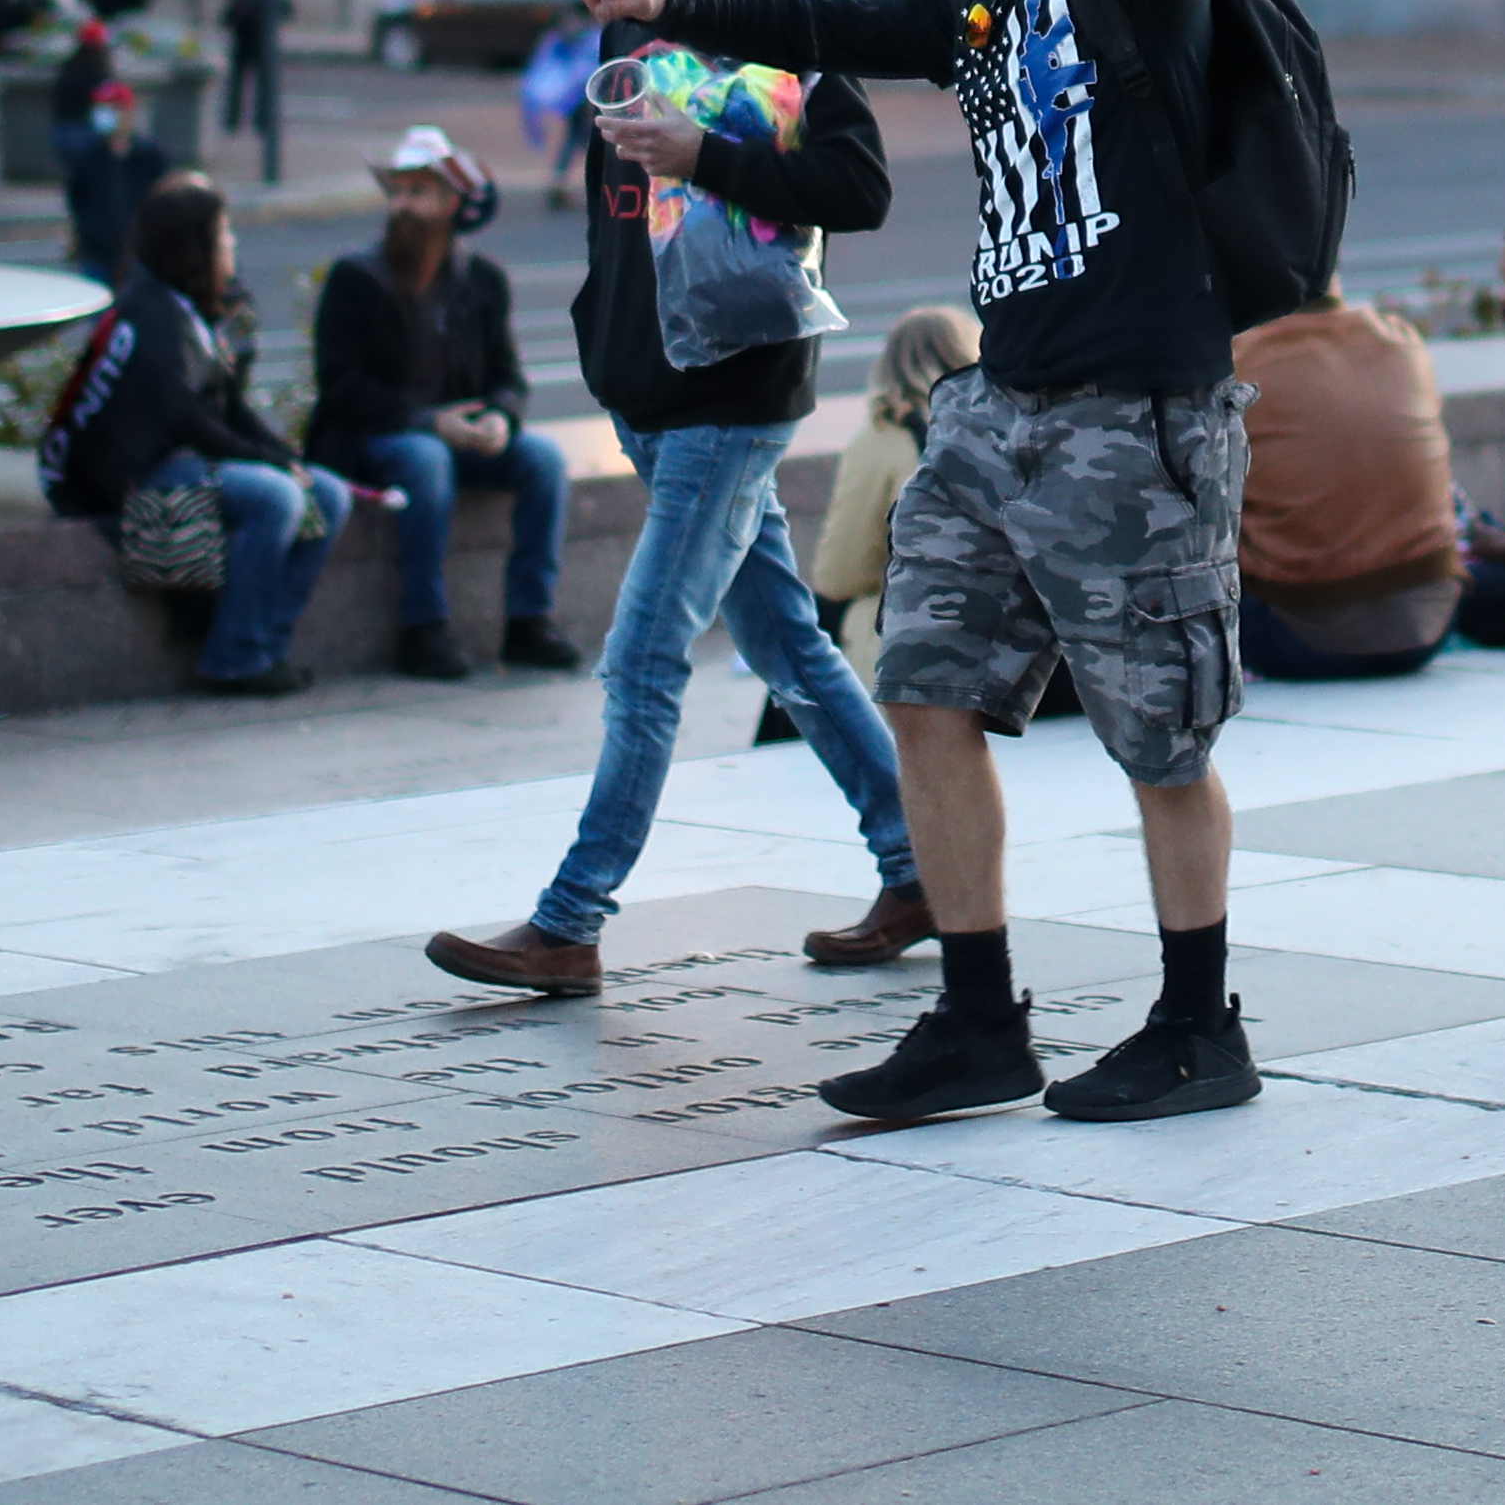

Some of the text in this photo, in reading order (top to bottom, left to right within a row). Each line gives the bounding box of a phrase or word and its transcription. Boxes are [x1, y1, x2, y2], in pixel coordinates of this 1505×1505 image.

[970, 211, 1121, 286] RUMP
[978, 254, 1086, 306] 2020
[594, 985, 769, 1012] look
[743, 985, 946, 1026] assed
[107, 1030, 289, 1056] this
[203, 1018, 563, 1080] westward
[598, 1032, 700, 1048] in
[401, 1058, 551, 1082] the
[465, 1056, 764, 1111] outlook
[17, 1082, 155, 1108] far
[54, 1090, 343, 1136] world.
[200, 1117, 422, 1154] from
[300, 1130, 582, 1184] should
[34, 1192, 217, 1229] ever
